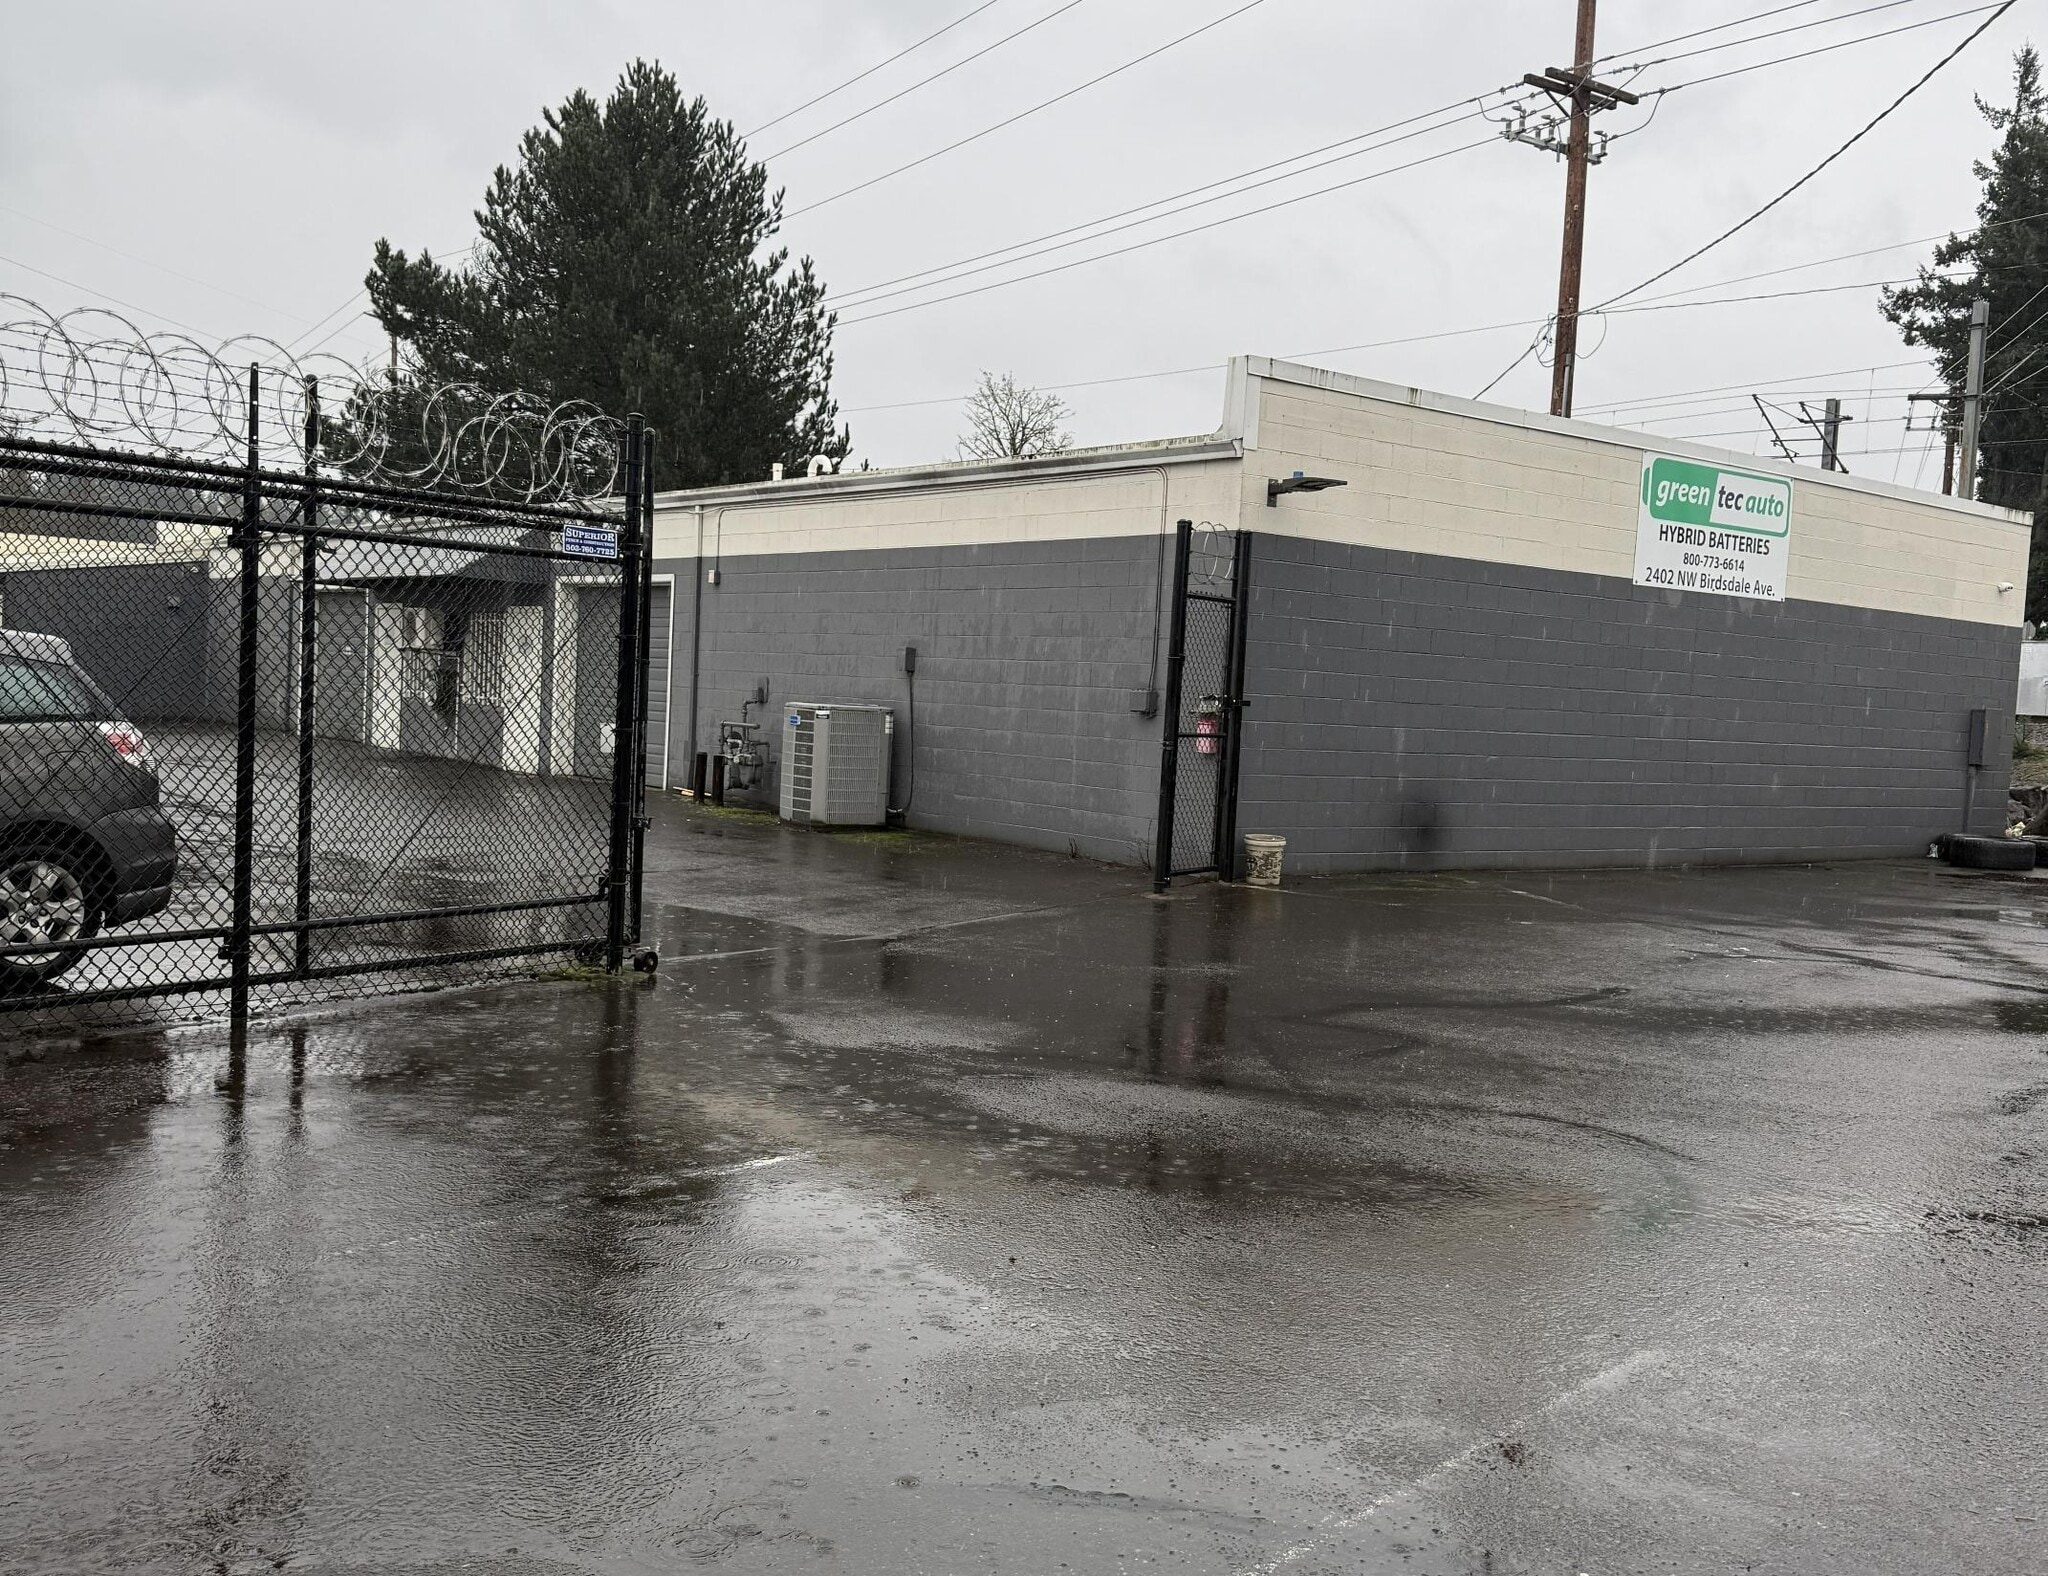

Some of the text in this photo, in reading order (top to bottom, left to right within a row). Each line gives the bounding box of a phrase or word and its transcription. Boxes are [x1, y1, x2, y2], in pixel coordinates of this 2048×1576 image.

[1656, 480, 1784, 518] green tec auto
[566, 528, 615, 542] SUPERIOR
[1659, 523, 1770, 556] HYBRID BATTERIES
[1683, 552, 1745, 572] 800-773-6614
[1645, 566, 1776, 597] 2402 NW Birdsdale Ave.
